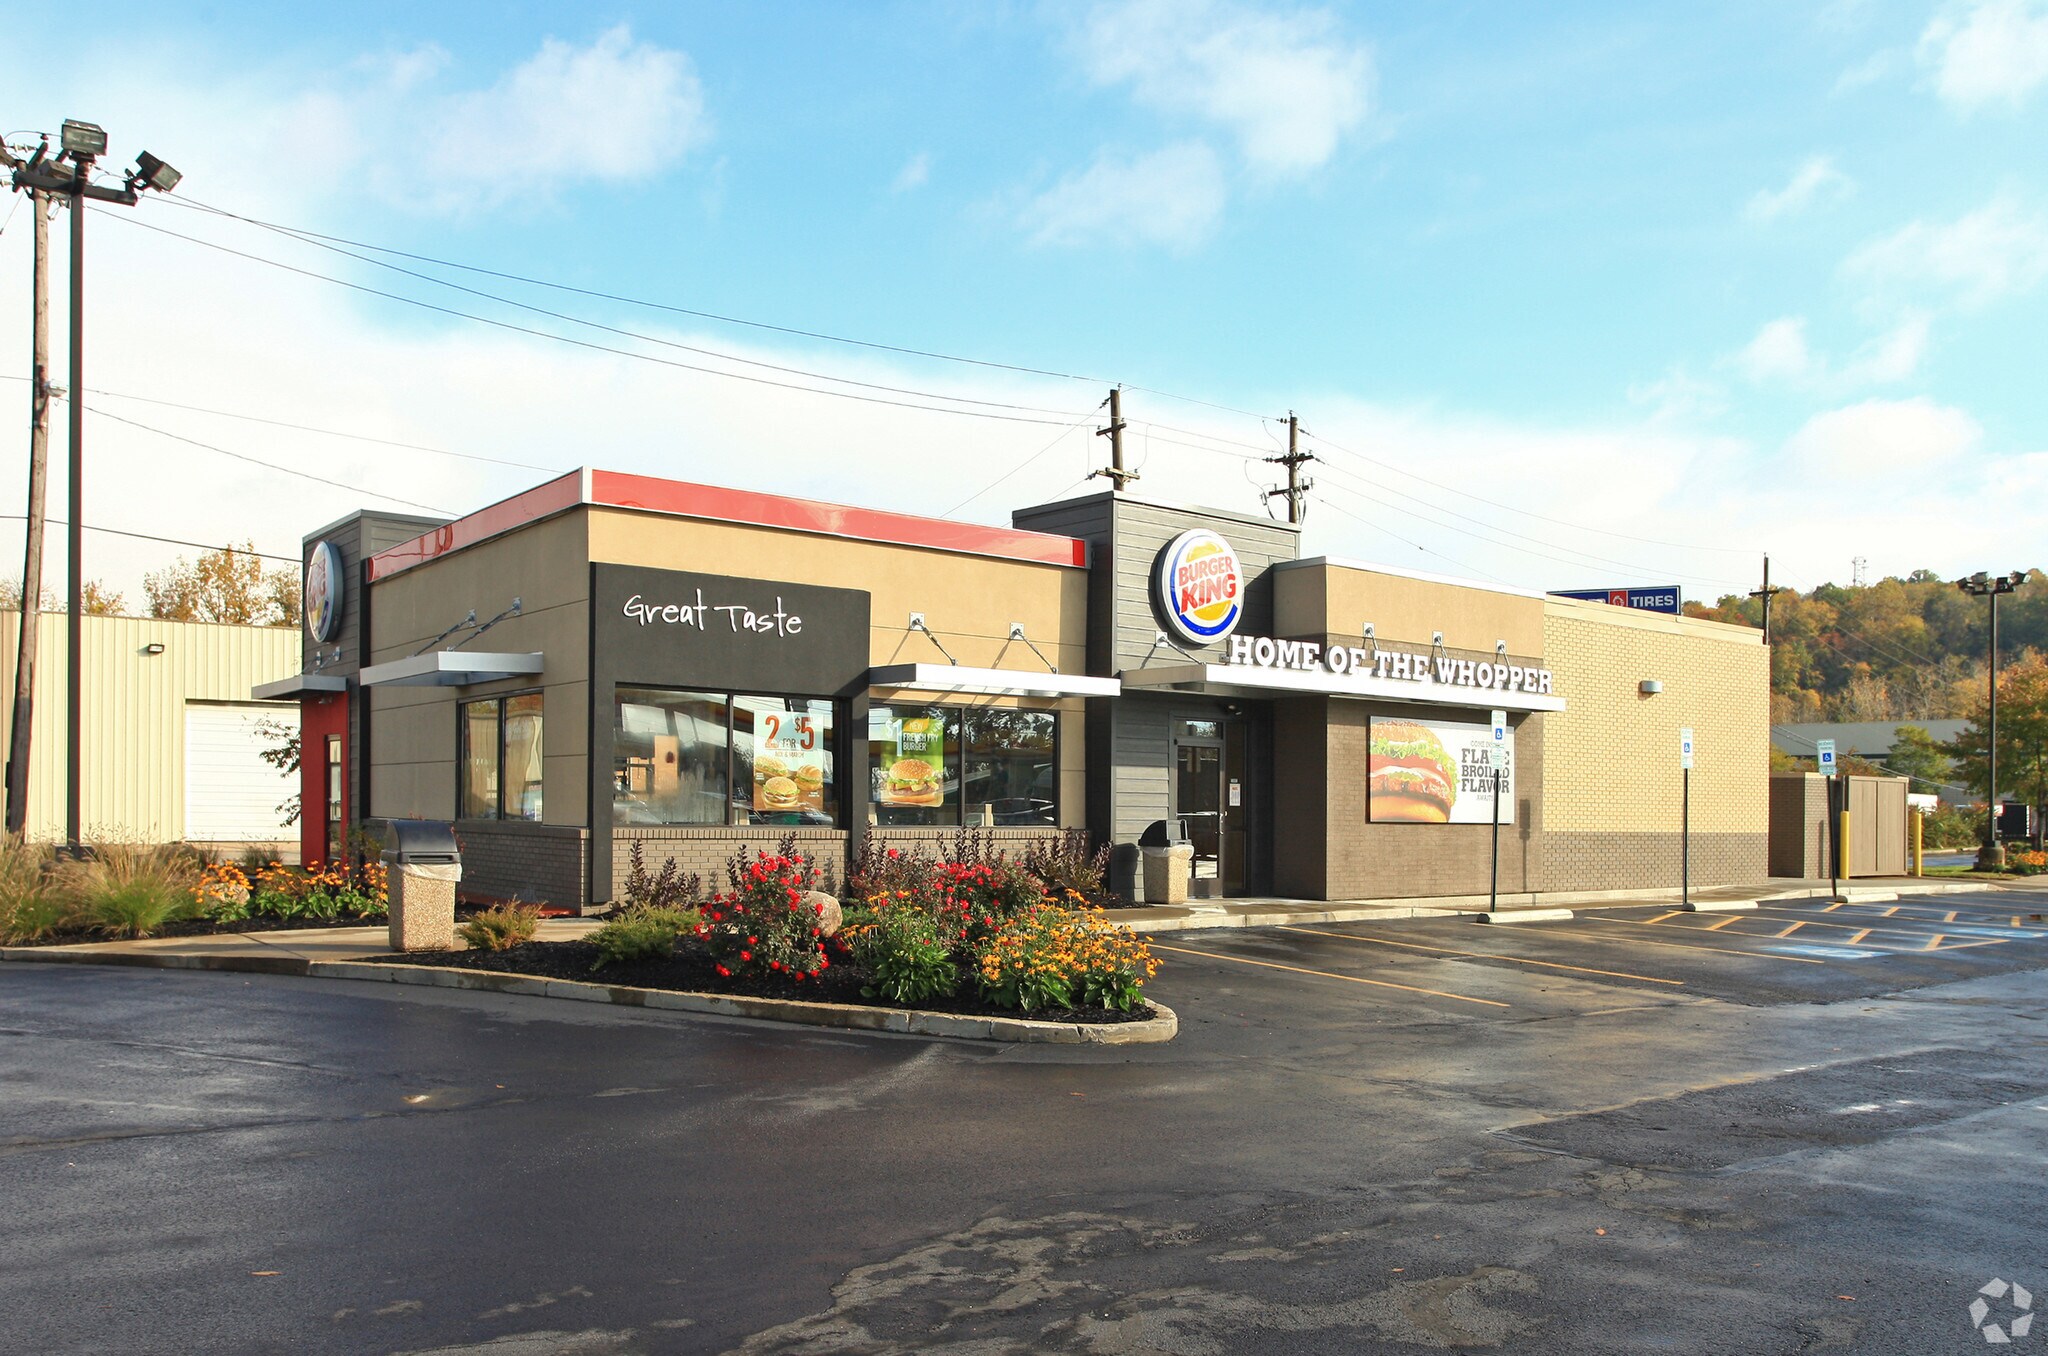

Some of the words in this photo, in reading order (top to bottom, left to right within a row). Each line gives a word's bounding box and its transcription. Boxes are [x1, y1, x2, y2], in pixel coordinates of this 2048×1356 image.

[1179, 556, 1234, 586] BURGER
[1181, 573, 1236, 613] KING
[1631, 595, 1674, 608] TIRES
[622, 588, 708, 631] Great
[713, 596, 802, 638] Taste
[1230, 634, 1320, 671] HOME
[1327, 645, 1366, 675] OF
[1373, 650, 1429, 682] THE
[1435, 657, 1553, 694] WHOPPER
[765, 714, 780, 749] 2
[782, 738, 797, 748] FOR
[794, 716, 815, 750] $5
[1461, 748, 1510, 765] FLAE
[1461, 764, 1510, 779] BROILD
